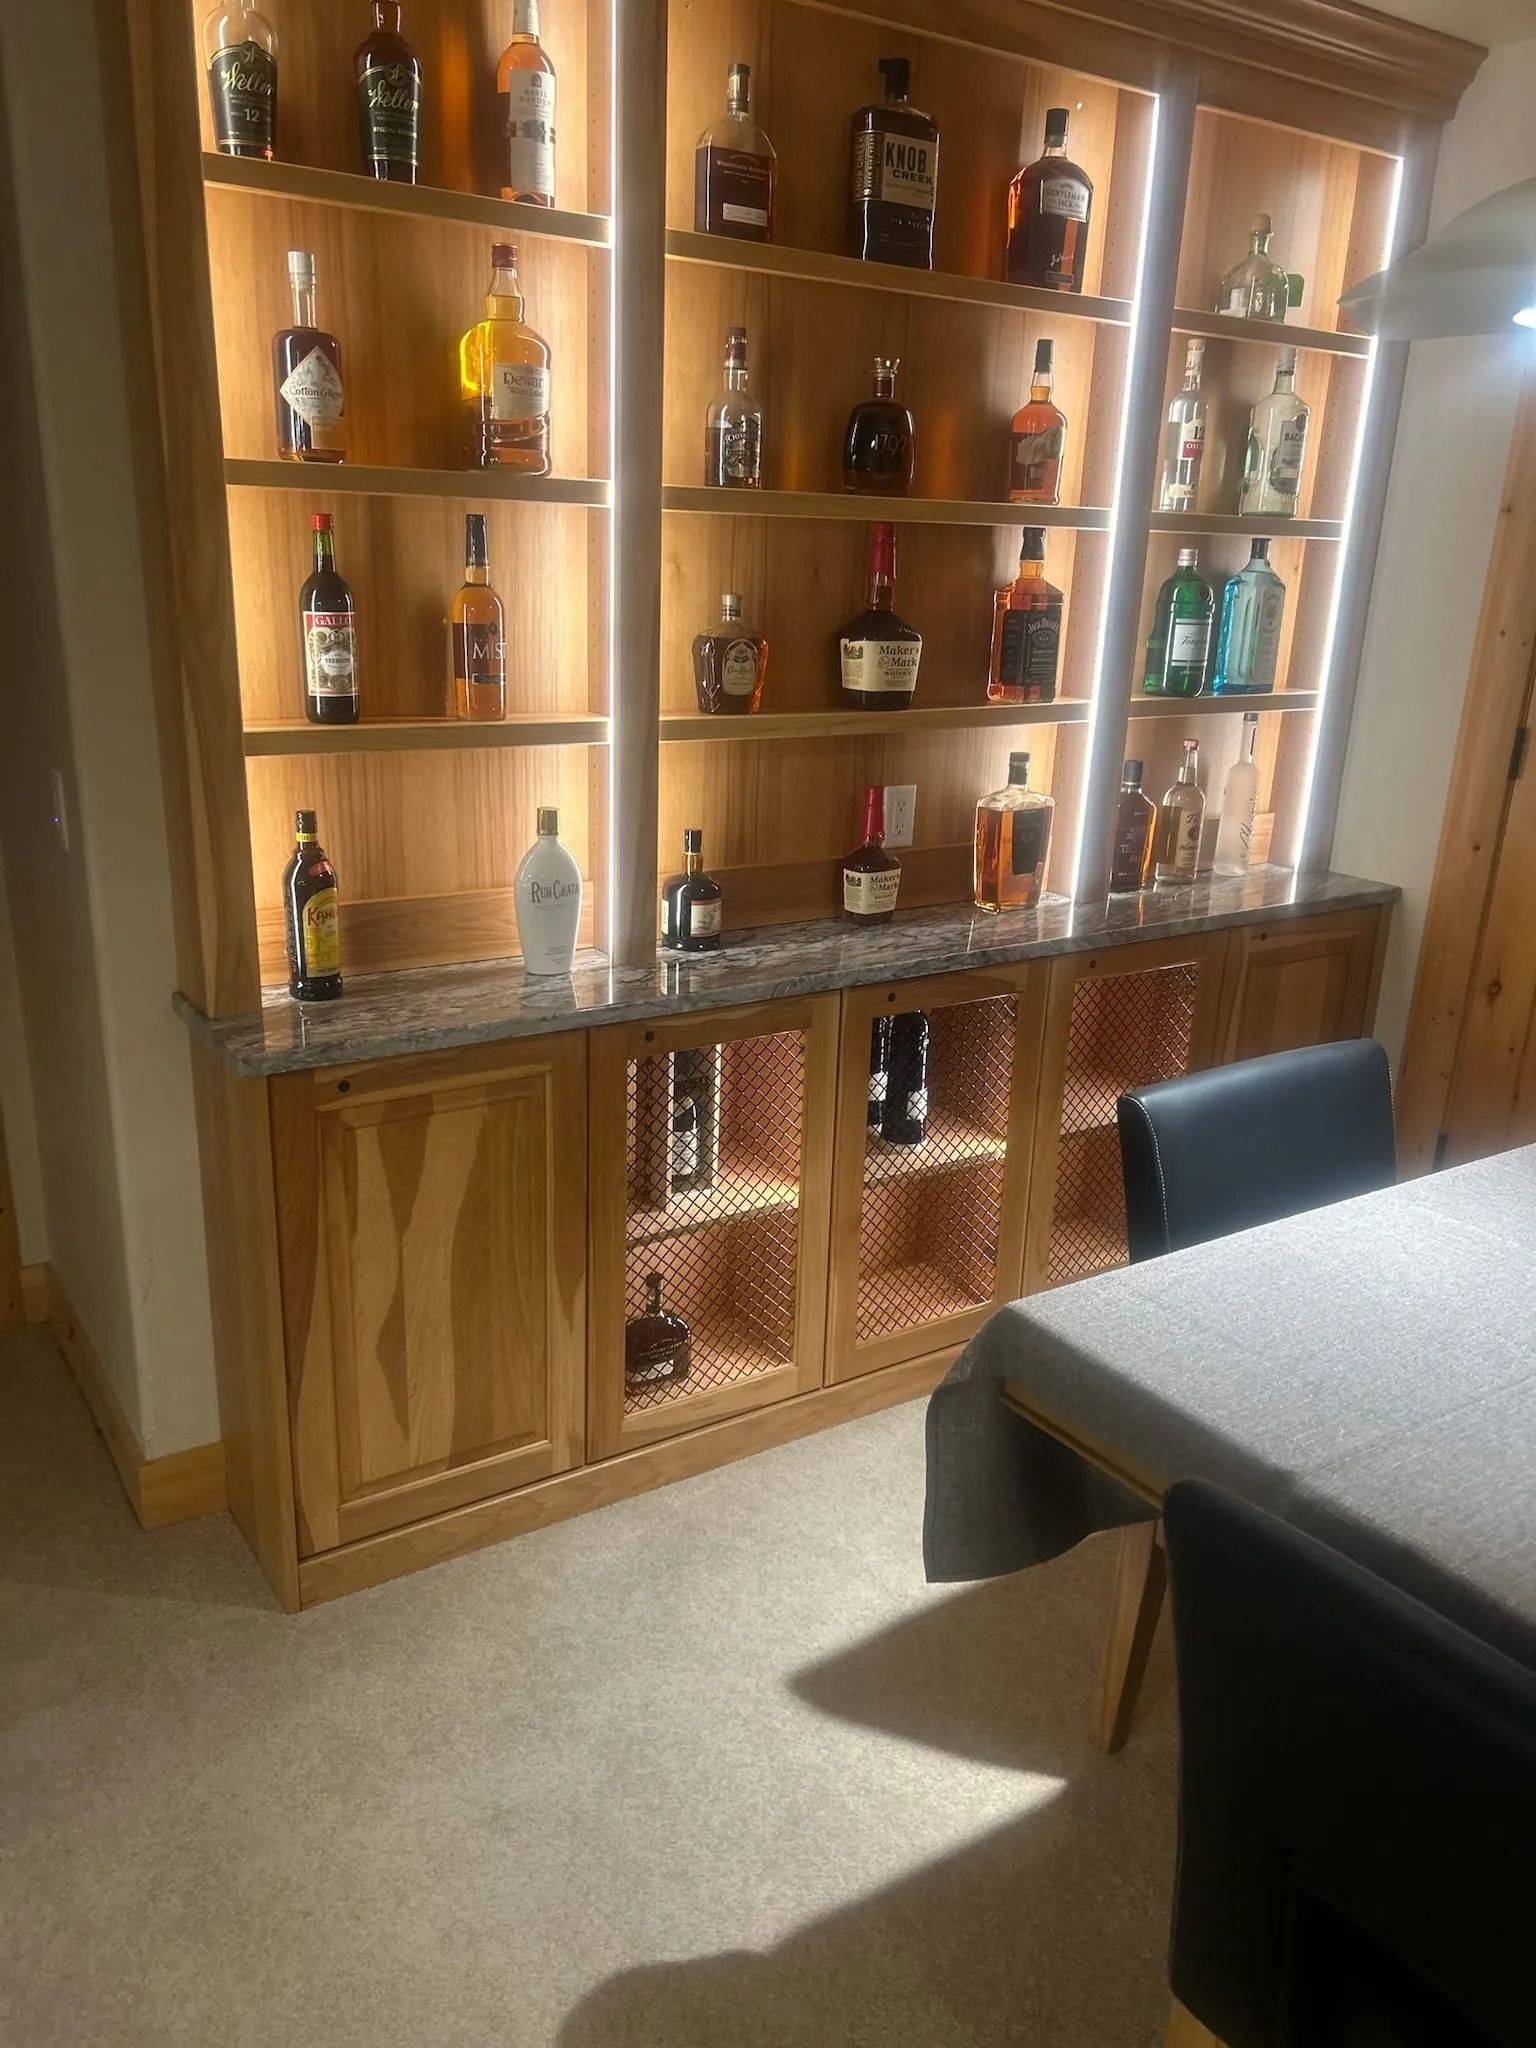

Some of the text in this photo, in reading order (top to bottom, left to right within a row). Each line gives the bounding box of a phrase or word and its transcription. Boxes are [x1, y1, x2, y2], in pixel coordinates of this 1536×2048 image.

[221, 61, 272, 96] Weller
[368, 80, 418, 112] Weller
[243, 107, 260, 122] 12
[885, 142, 926, 172] KNOB
[893, 169, 933, 184] CREEK
[1046, 188, 1086, 201] GENTLEMAN
[289, 386, 319, 396] Cotton
[1193, 426, 1205, 440] 12
[316, 615, 351, 626] GALLO
[472, 642, 506, 659] MIST
[880, 645, 920, 655] Maker's
[891, 657, 918, 667] Mark
